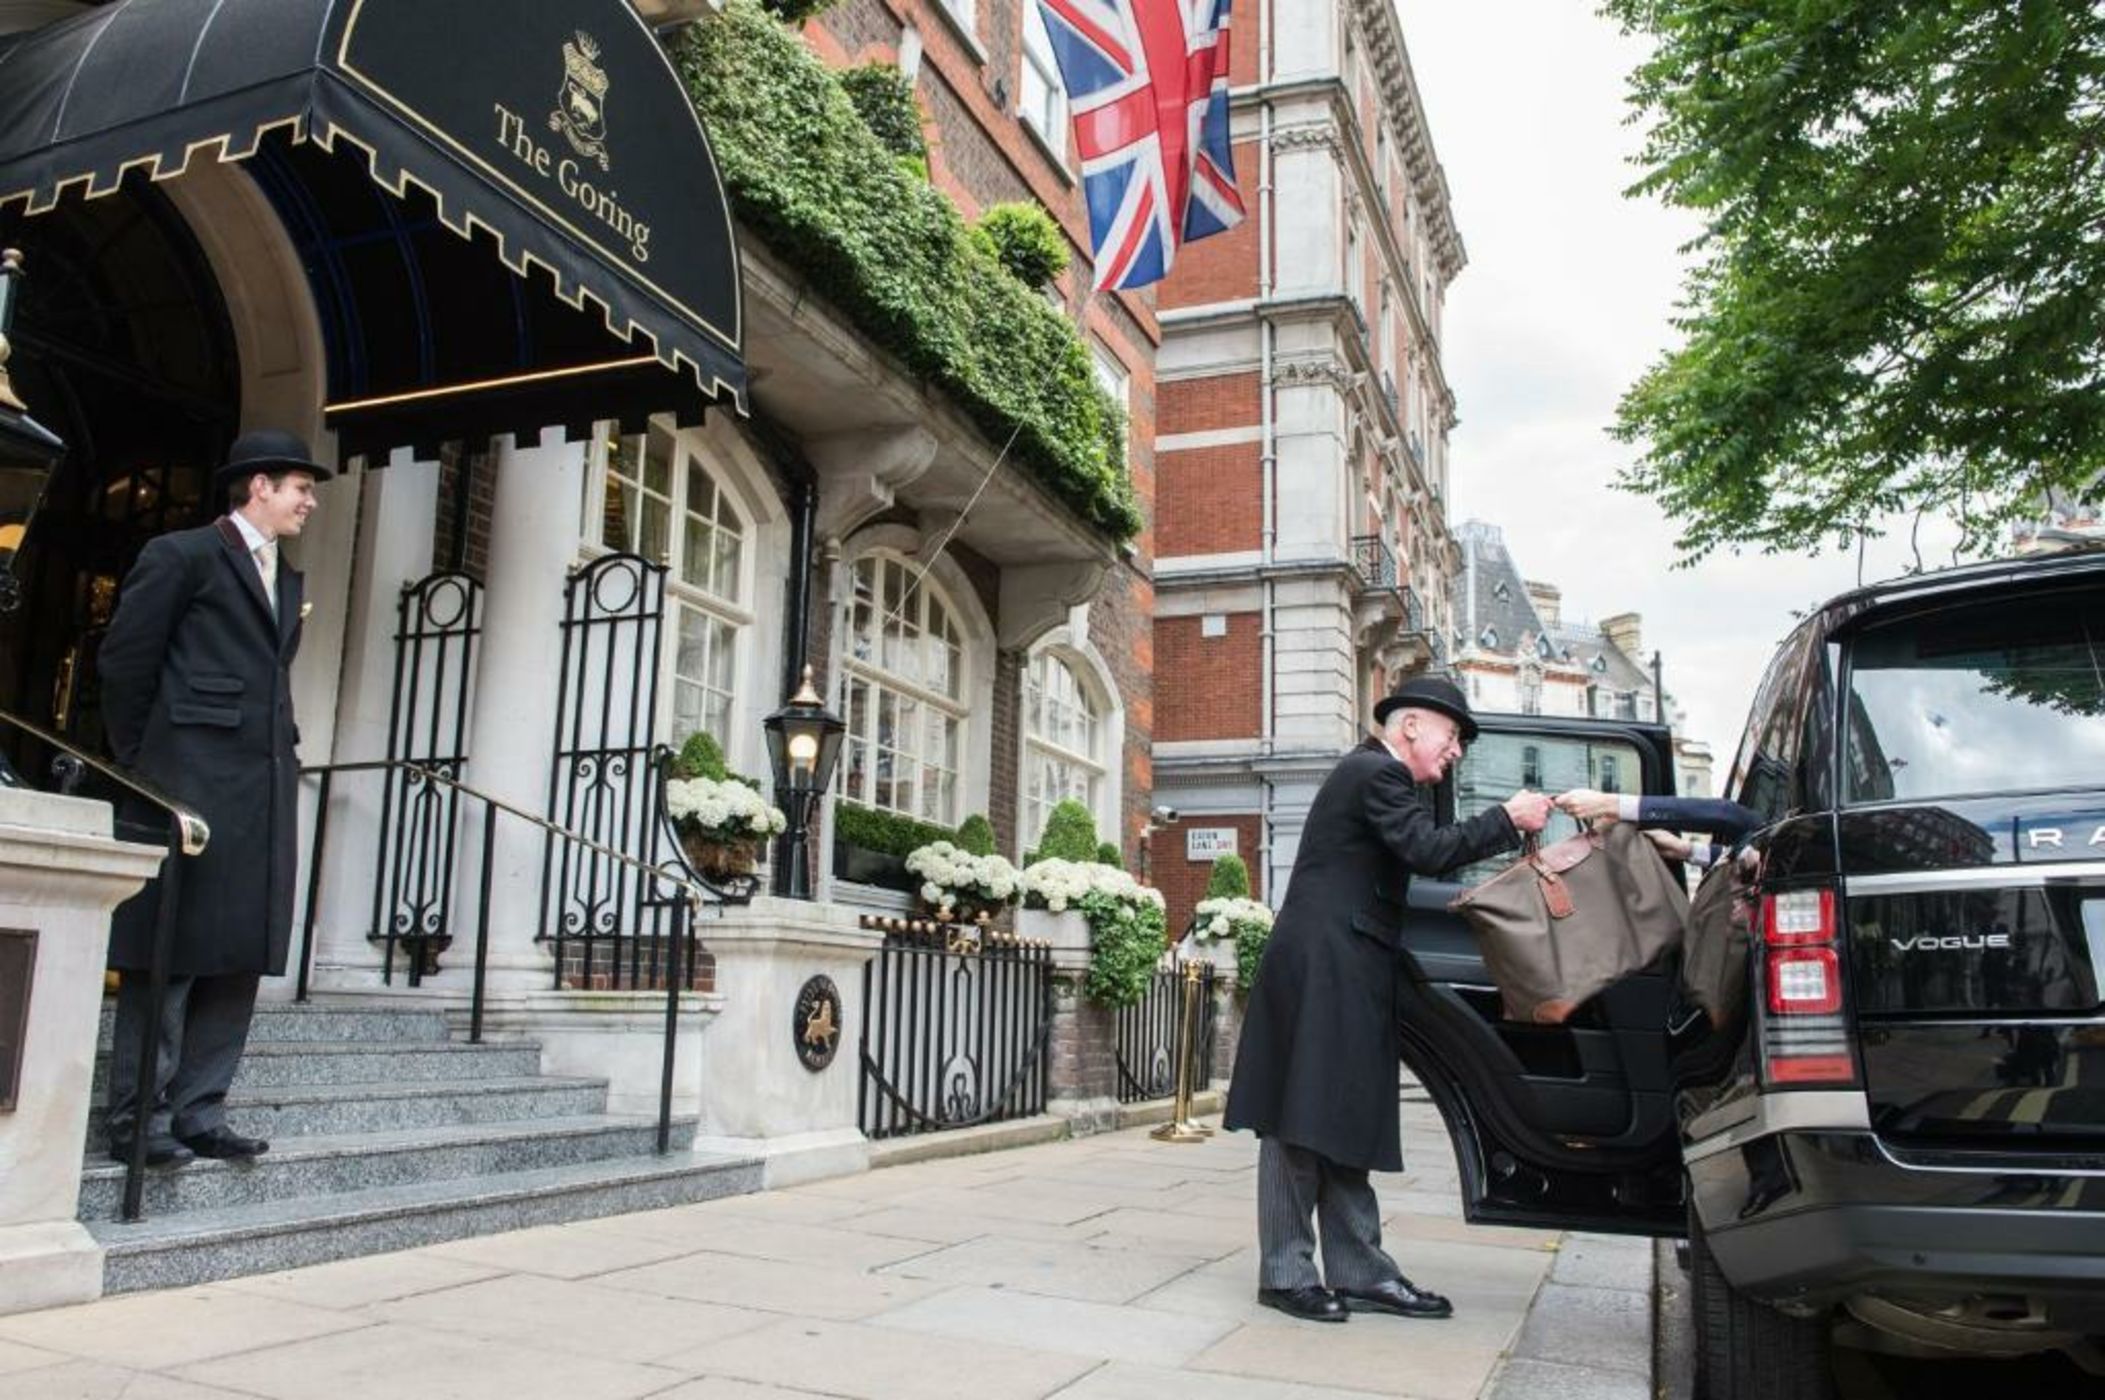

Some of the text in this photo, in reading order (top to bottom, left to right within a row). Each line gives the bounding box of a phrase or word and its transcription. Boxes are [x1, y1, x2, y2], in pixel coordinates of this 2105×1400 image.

[495, 103, 651, 262] The Goring
[1890, 934, 2010, 951] VOGUE
